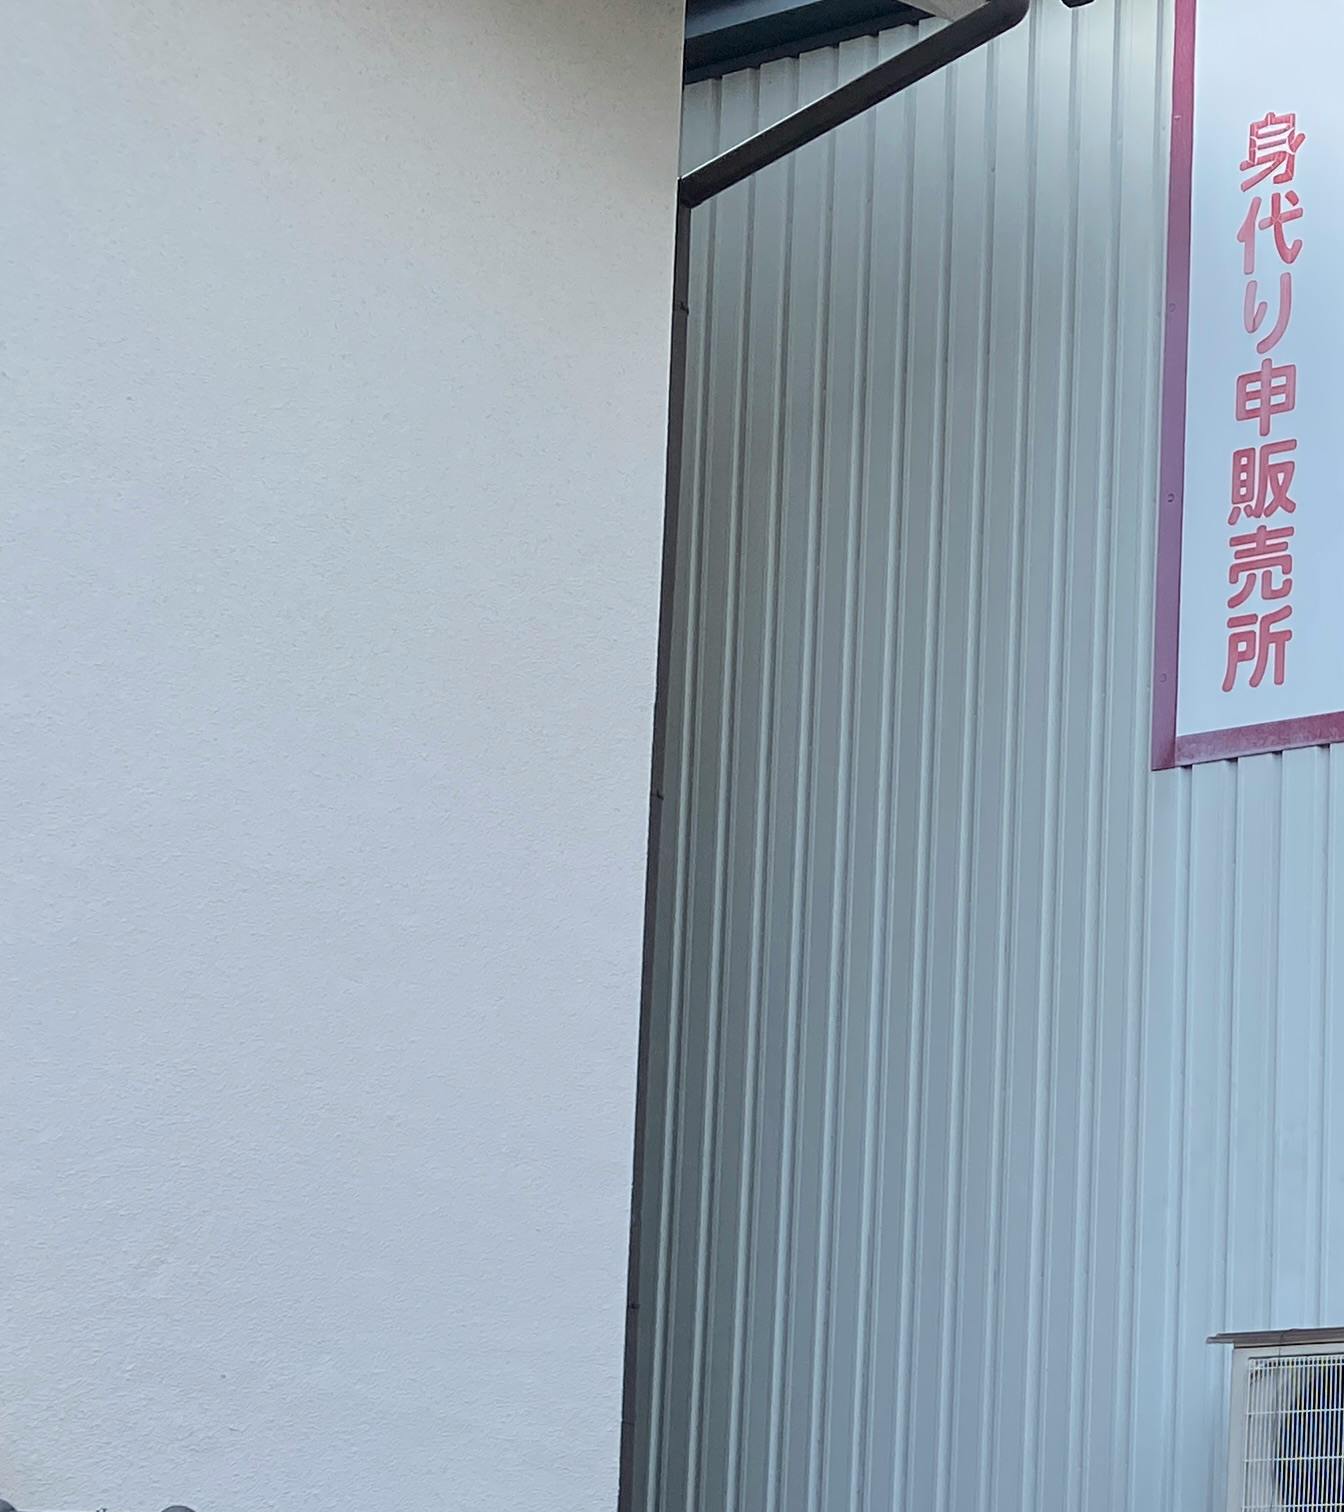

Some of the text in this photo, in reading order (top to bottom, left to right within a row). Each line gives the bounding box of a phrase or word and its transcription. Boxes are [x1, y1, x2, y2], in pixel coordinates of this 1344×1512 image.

[1221, 111, 1306, 693] 身代り申販売所
